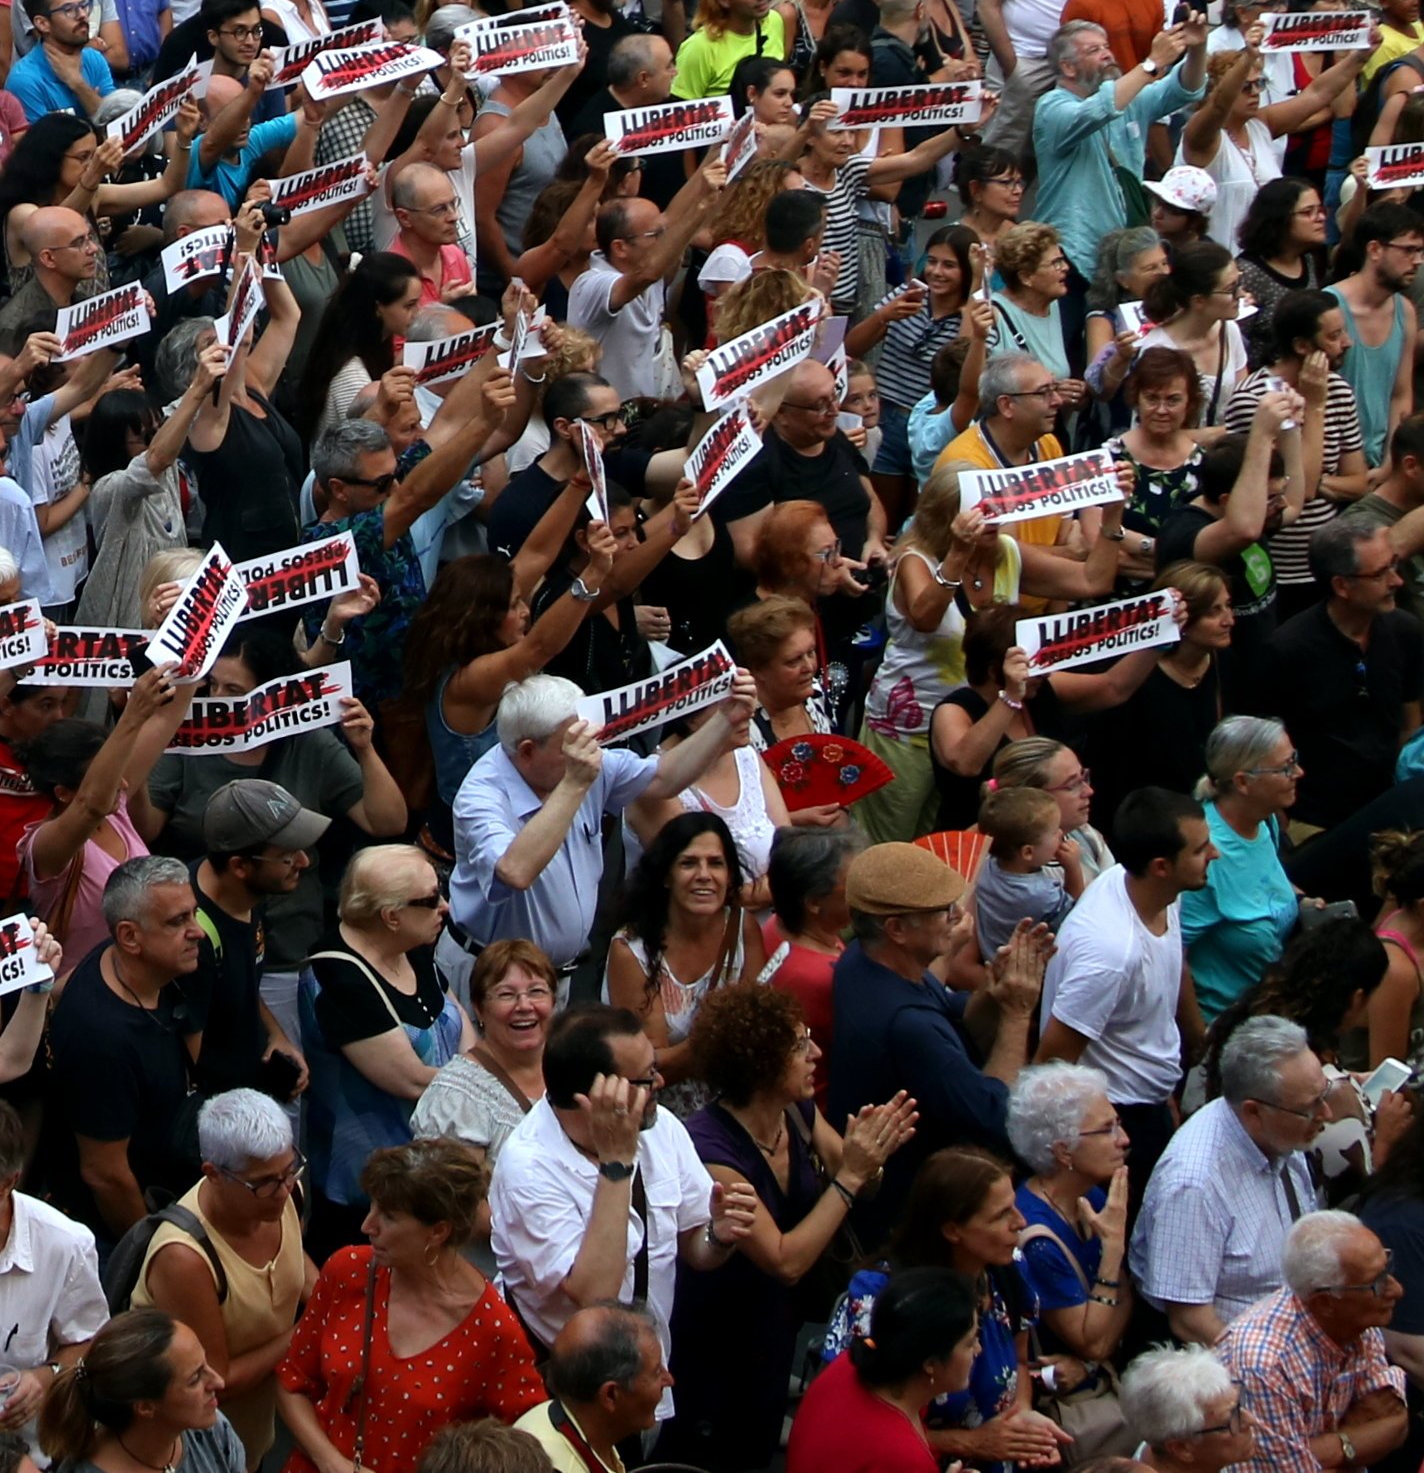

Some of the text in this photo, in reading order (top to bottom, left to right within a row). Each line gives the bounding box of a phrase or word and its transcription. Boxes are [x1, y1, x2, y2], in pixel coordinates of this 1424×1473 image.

[621, 102, 719, 134] LLIBERTAT
[845, 86, 960, 109] LLIBERTAT
[69, 287, 138, 329] LLIBERTAT
[978, 457, 1099, 497] LLIBERTAT
[161, 555, 226, 657] LLIBERTAT
[247, 568, 350, 614] LLIBER
[1039, 598, 1161, 646] LLIBERTAT
[44, 663, 135, 679] POLÍTICS
[603, 648, 729, 723] LLIBERTA
[192, 673, 324, 726] IBERTAT
